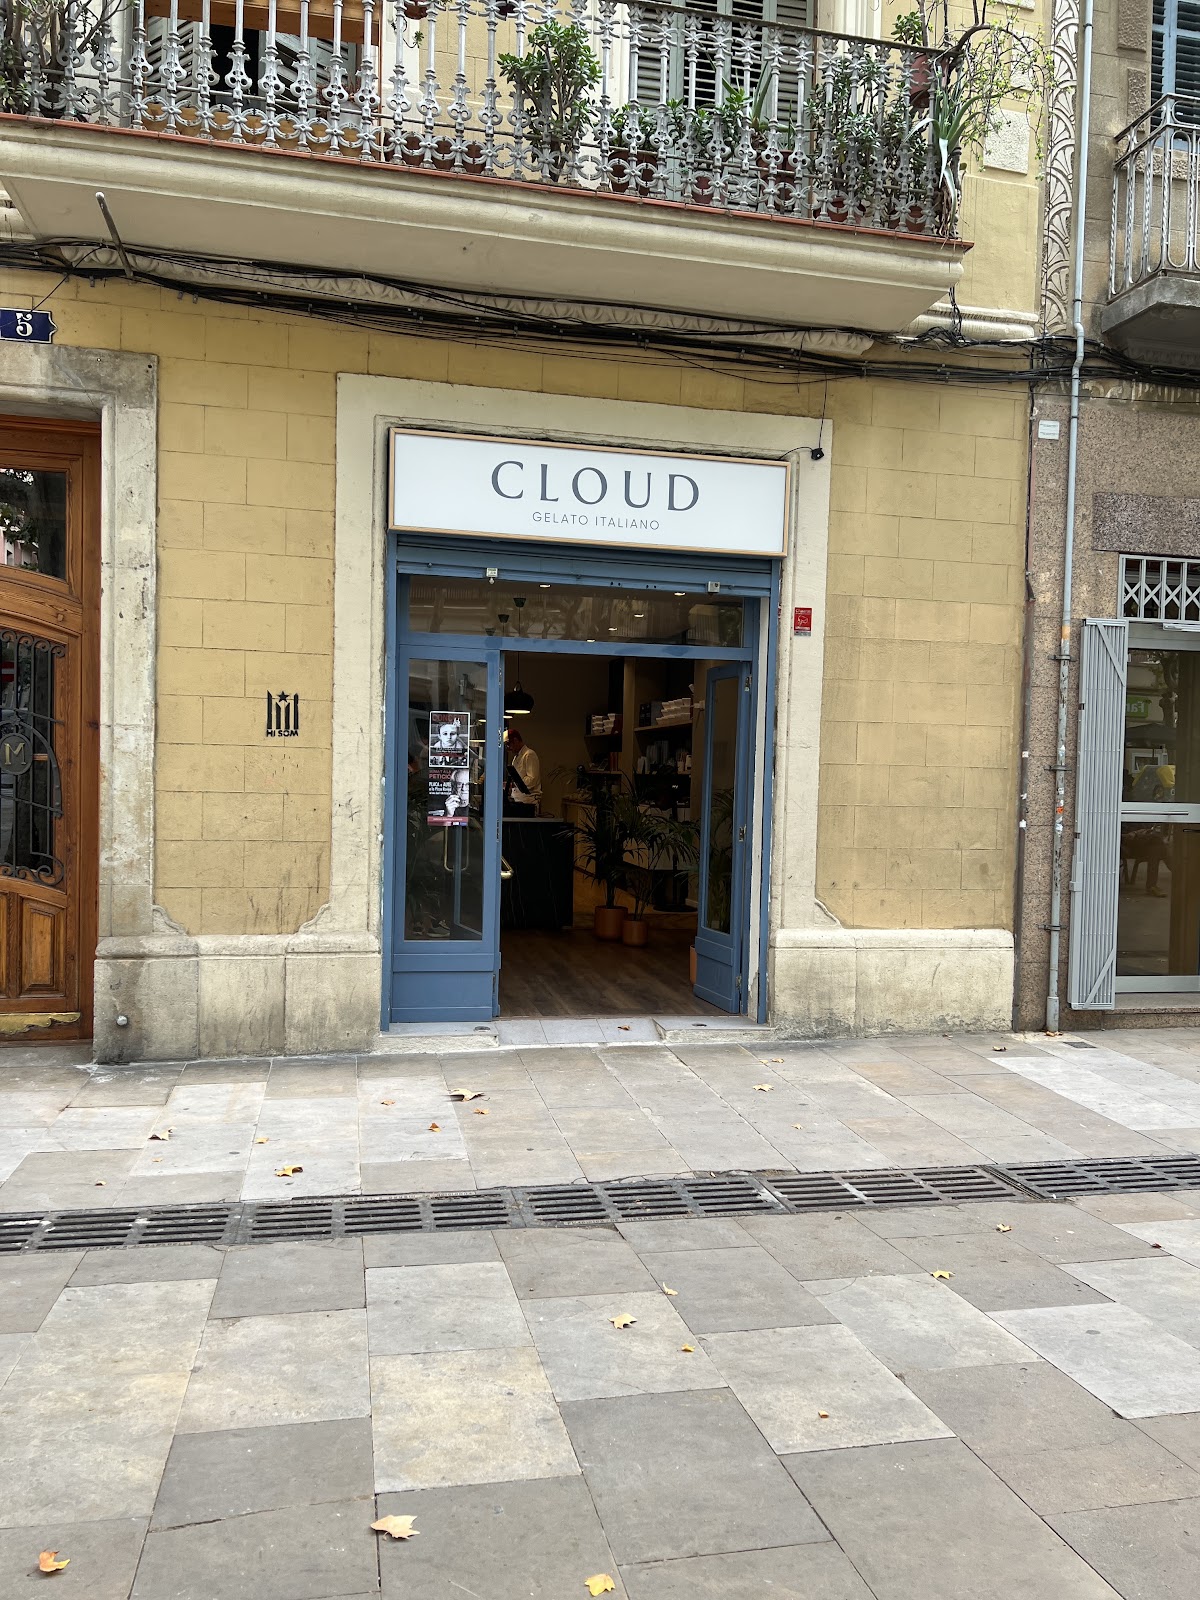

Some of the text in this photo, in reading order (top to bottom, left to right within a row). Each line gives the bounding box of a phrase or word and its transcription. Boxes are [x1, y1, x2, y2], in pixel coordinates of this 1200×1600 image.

[16, 312, 33, 337] 5
[491, 460, 699, 512] CLOUD
[532, 511, 660, 531] GELATO ITALIANO
[277, 729, 299, 737] SOM
[4, 743, 26, 765] M
